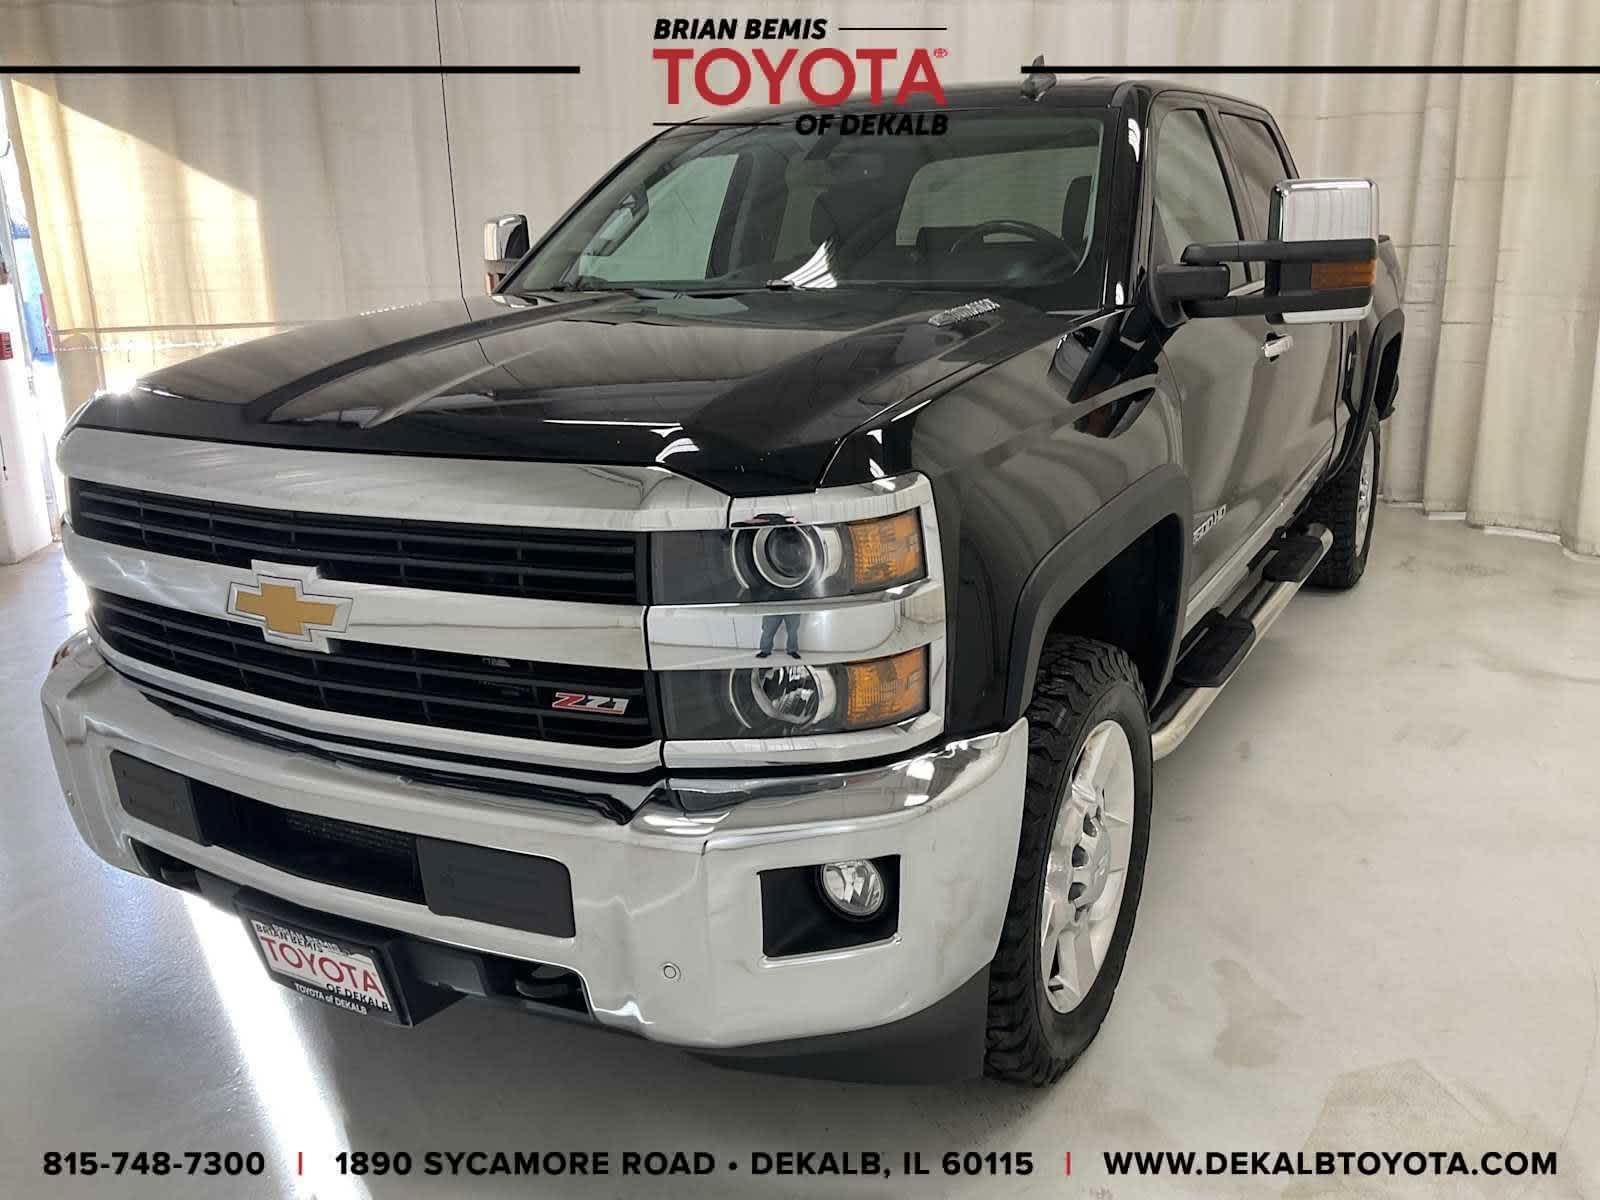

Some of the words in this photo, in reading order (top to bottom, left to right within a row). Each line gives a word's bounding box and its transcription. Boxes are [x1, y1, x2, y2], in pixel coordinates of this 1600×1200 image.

[552, 691, 629, 715] Z71
[260, 935, 385, 998] TOYOTA
[294, 982, 326, 1001] TOYOTA
[334, 997, 368, 1016] DEKALB
[326, 983, 342, 996] OF
